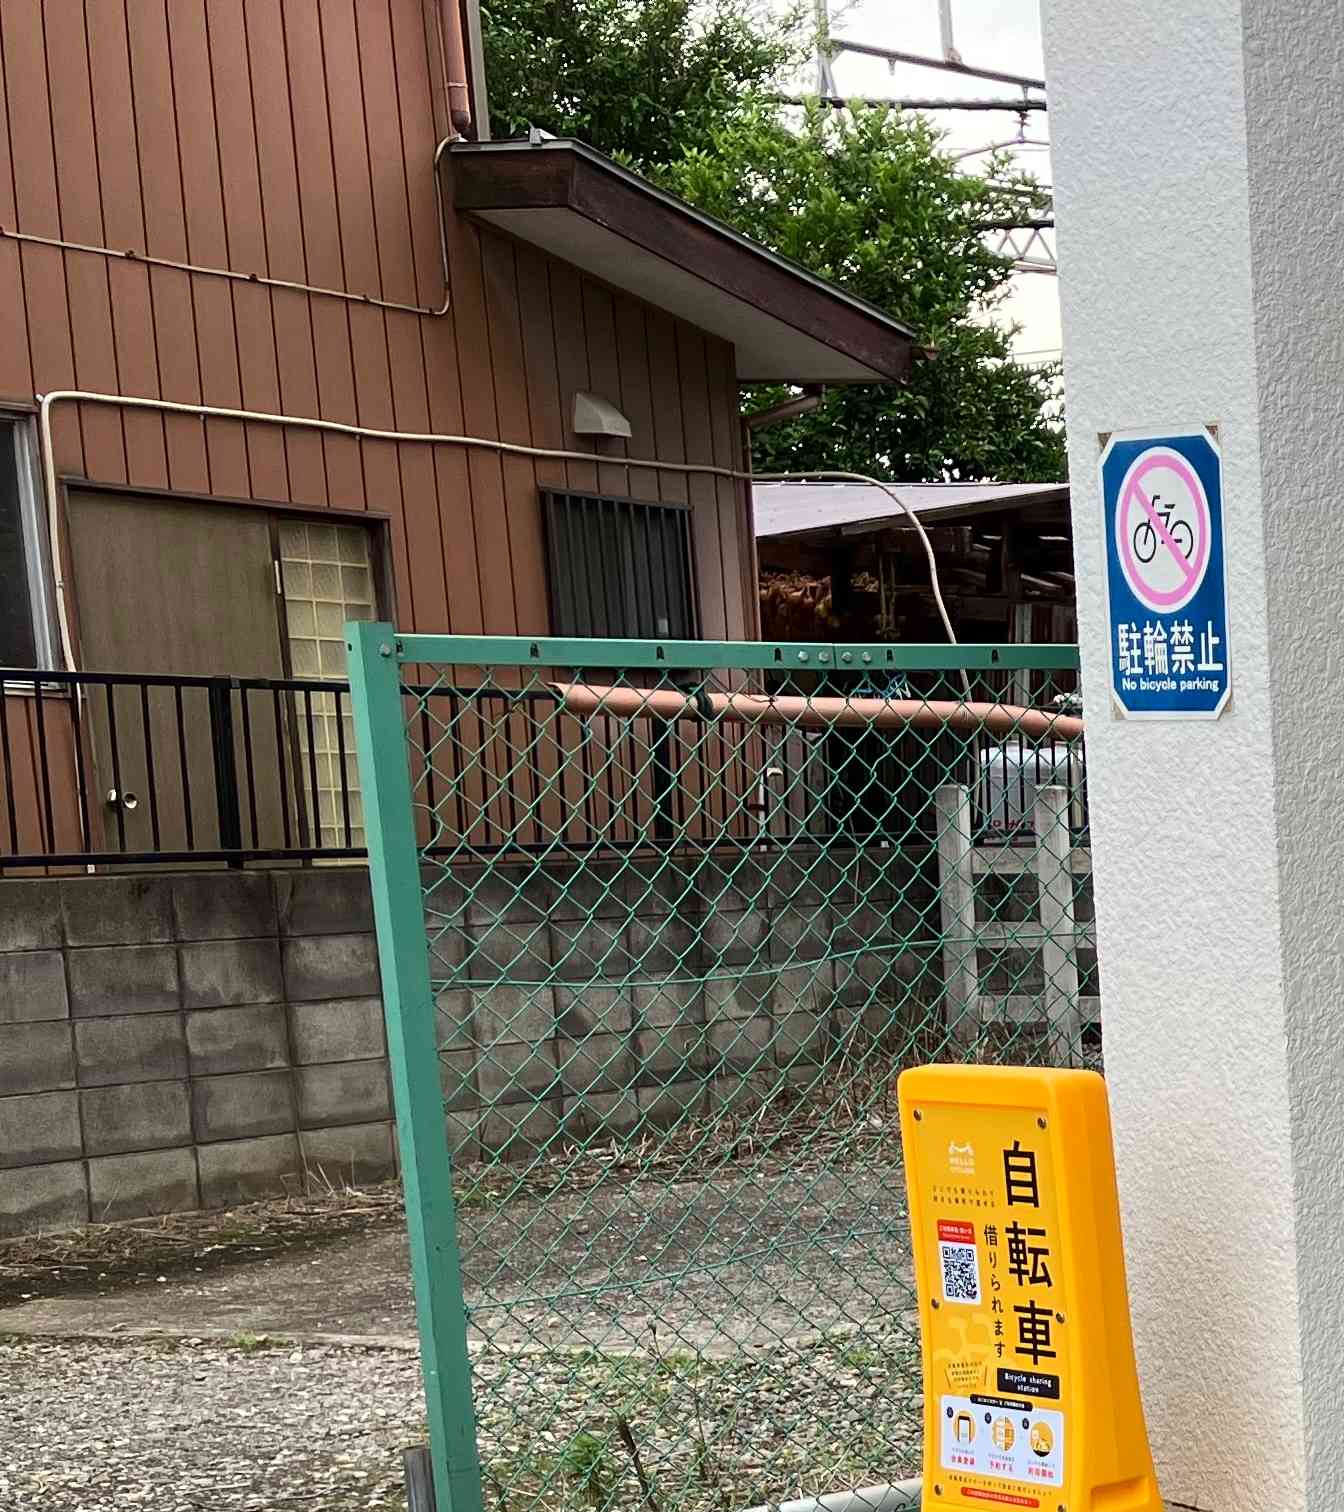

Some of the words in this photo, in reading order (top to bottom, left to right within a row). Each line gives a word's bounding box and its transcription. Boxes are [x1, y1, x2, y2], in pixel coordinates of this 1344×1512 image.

[1118, 619, 1223, 675] 駐輪禁止
[1122, 678, 1137, 691] No
[1140, 677, 1177, 692] bicycle
[1180, 677, 1220, 692] parking
[1003, 1140, 1057, 1365] 自転車
[984, 1224, 1006, 1358] 借りられます
[1004, 1372, 1027, 1384] Bicycle
[1029, 1375, 1052, 1388] sharing
[1017, 1384, 1039, 1393] station
